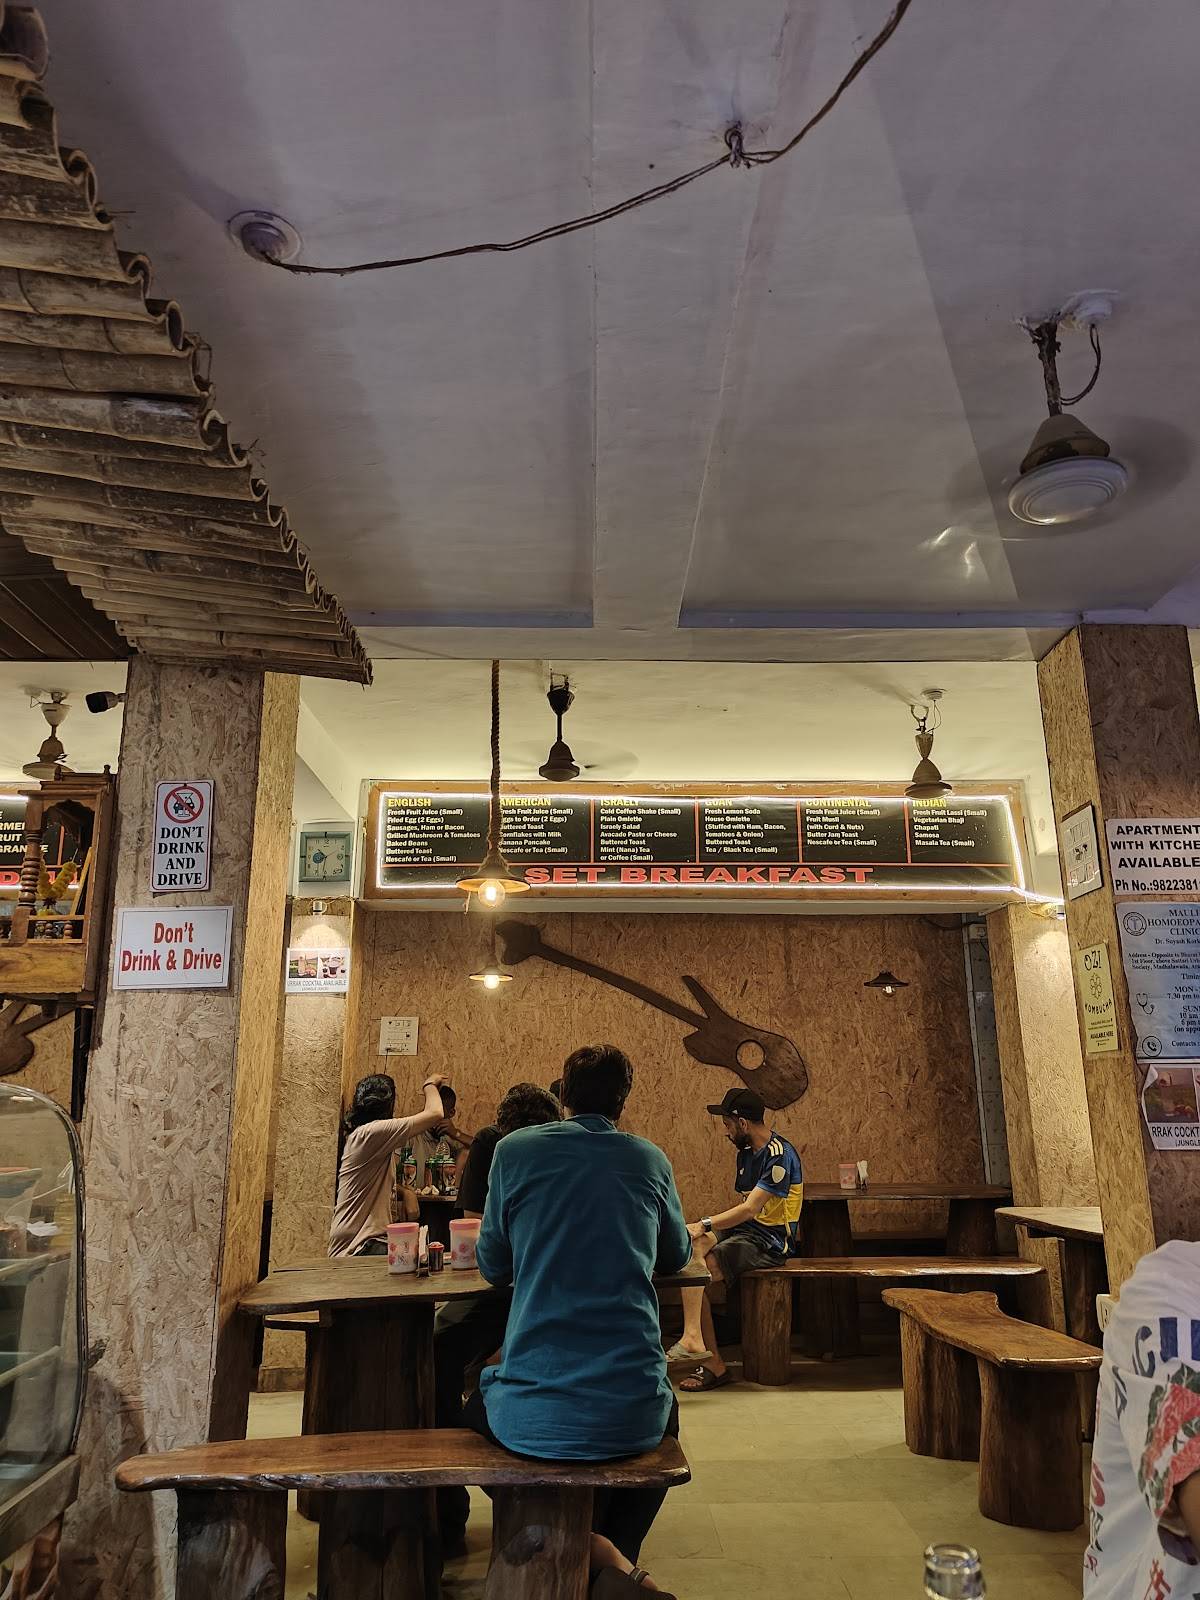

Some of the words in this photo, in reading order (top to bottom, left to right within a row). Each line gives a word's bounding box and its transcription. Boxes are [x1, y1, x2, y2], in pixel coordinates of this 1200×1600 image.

[388, 798, 432, 806] ENGLISH
[500, 798, 551, 806] AMERICAN
[806, 799, 871, 807] CONTINENTAL
[913, 799, 947, 807] INDIAN
[161, 826, 204, 839] DON'T
[158, 842, 204, 854] DRINK
[1111, 841, 1144, 850] WITH
[166, 858, 195, 869] AND
[1118, 857, 1200, 868] AVAILABLE
[157, 873, 202, 885] DRIVE
[525, 868, 606, 883] SET
[620, 868, 873, 883] BREAKFAST
[1115, 880, 1129, 891] Ph
[154, 922, 194, 943] Don't
[122, 949, 161, 972] Drink
[166, 949, 177, 971] &
[183, 948, 222, 970] Drive
[1175, 1127, 1199, 1137] COCKT
